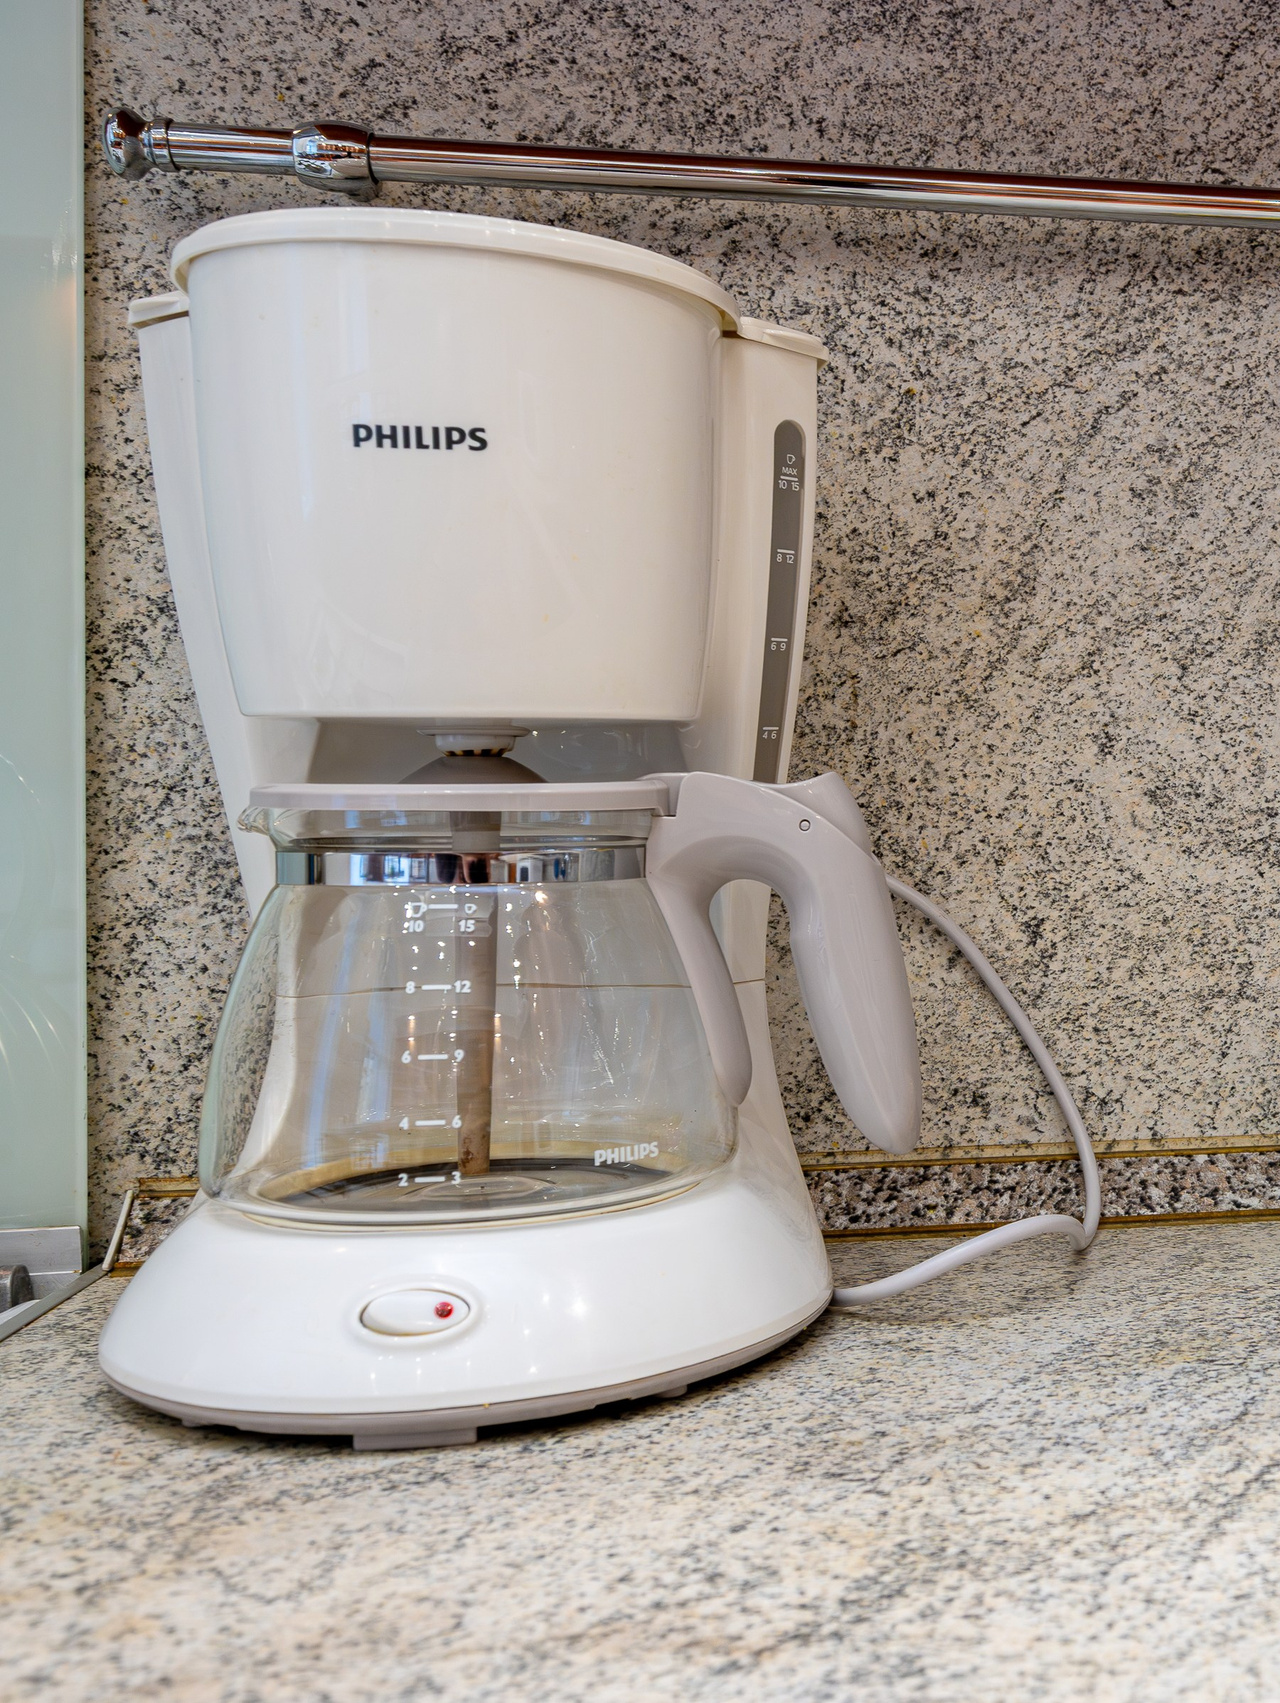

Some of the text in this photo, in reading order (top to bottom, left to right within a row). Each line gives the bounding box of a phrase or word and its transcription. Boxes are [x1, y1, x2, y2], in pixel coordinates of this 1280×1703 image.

[352, 424, 488, 451] PHILIPS
[781, 466, 798, 476] MAX
[778, 480, 800, 492] 10 15
[776, 553, 795, 564] 8 12
[770, 641, 787, 652] 6 9
[762, 730, 778, 740] 4 6
[407, 919, 476, 933] 10 15
[405, 980, 472, 994] 8 12
[401, 1049, 465, 1064] 6 9
[399, 1115, 462, 1130] 4 6
[594, 1141, 660, 1166] PHILIPS
[398, 1172, 462, 1187] 2 3
